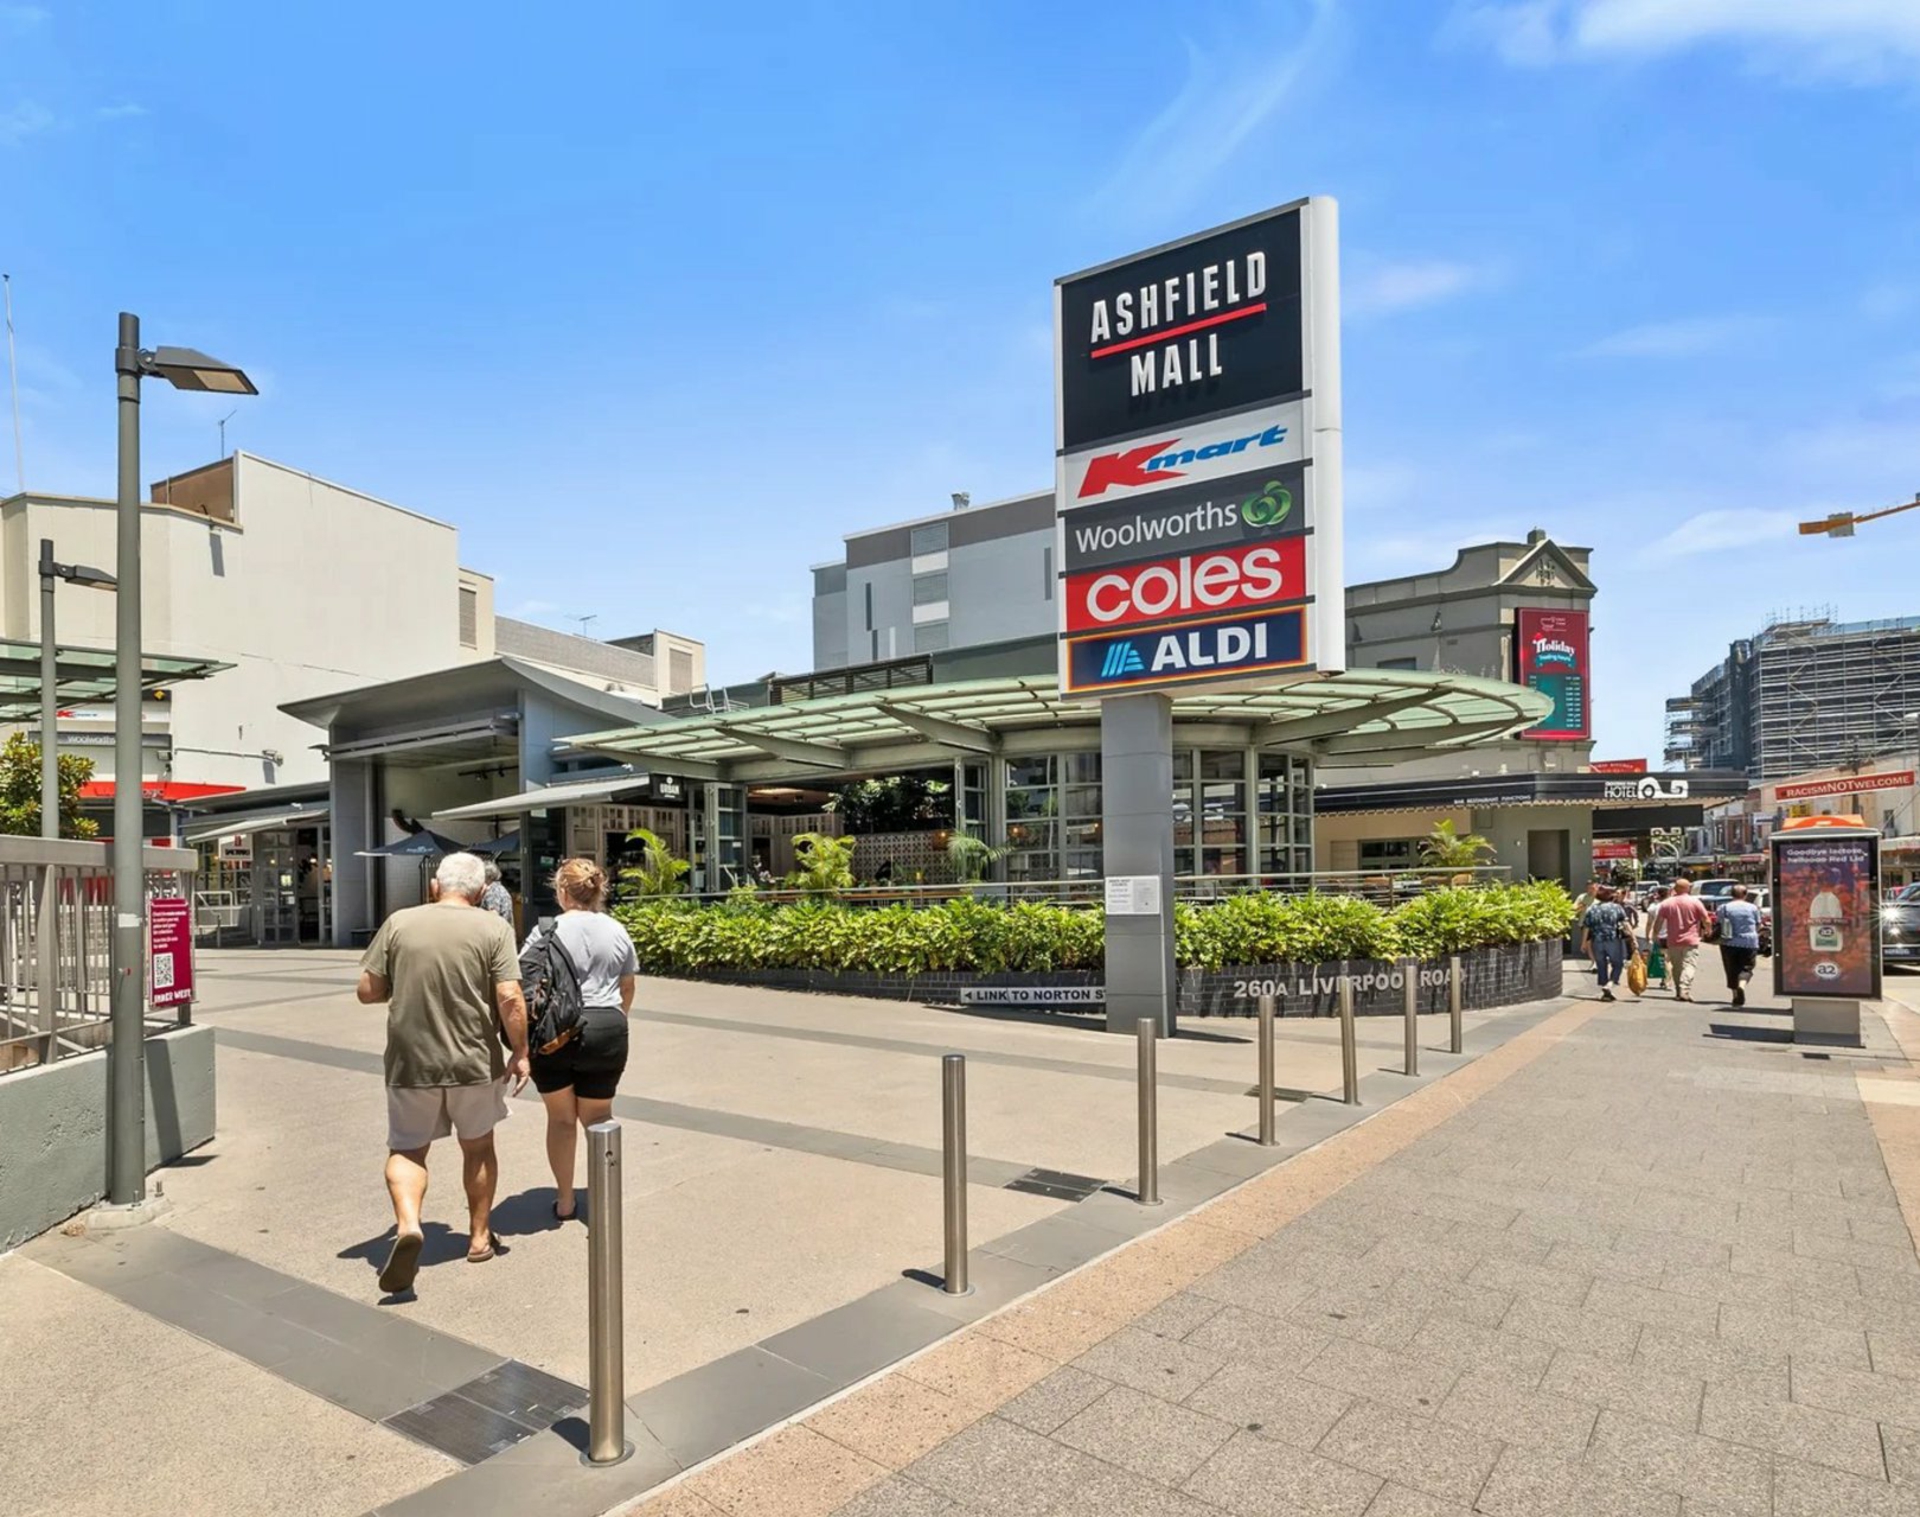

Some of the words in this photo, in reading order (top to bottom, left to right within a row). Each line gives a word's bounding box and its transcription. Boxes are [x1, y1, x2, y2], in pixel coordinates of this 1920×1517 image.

[1091, 251, 1266, 343] ASHFIELD
[1131, 333, 1222, 396] MALL
[1078, 424, 1288, 499] Kmart
[1075, 501, 1238, 553] Woolworths
[1087, 548, 1283, 622] coles
[1151, 622, 1268, 671] ALDI
[1535, 639, 1576, 657] Holiday
[67, 735, 116, 745] Woolworth
[1604, 785, 1638, 798] HOTEL
[1786, 847, 1827, 856] Goodbye
[1817, 965, 1836, 975] a2
[977, 990, 1006, 1001] LINK
[1011, 990, 1029, 1000] TO
[1033, 989, 1090, 1000] NORTON
[1233, 979, 1289, 998] 260A
[1299, 973, 1404, 996] LIVRPOO
